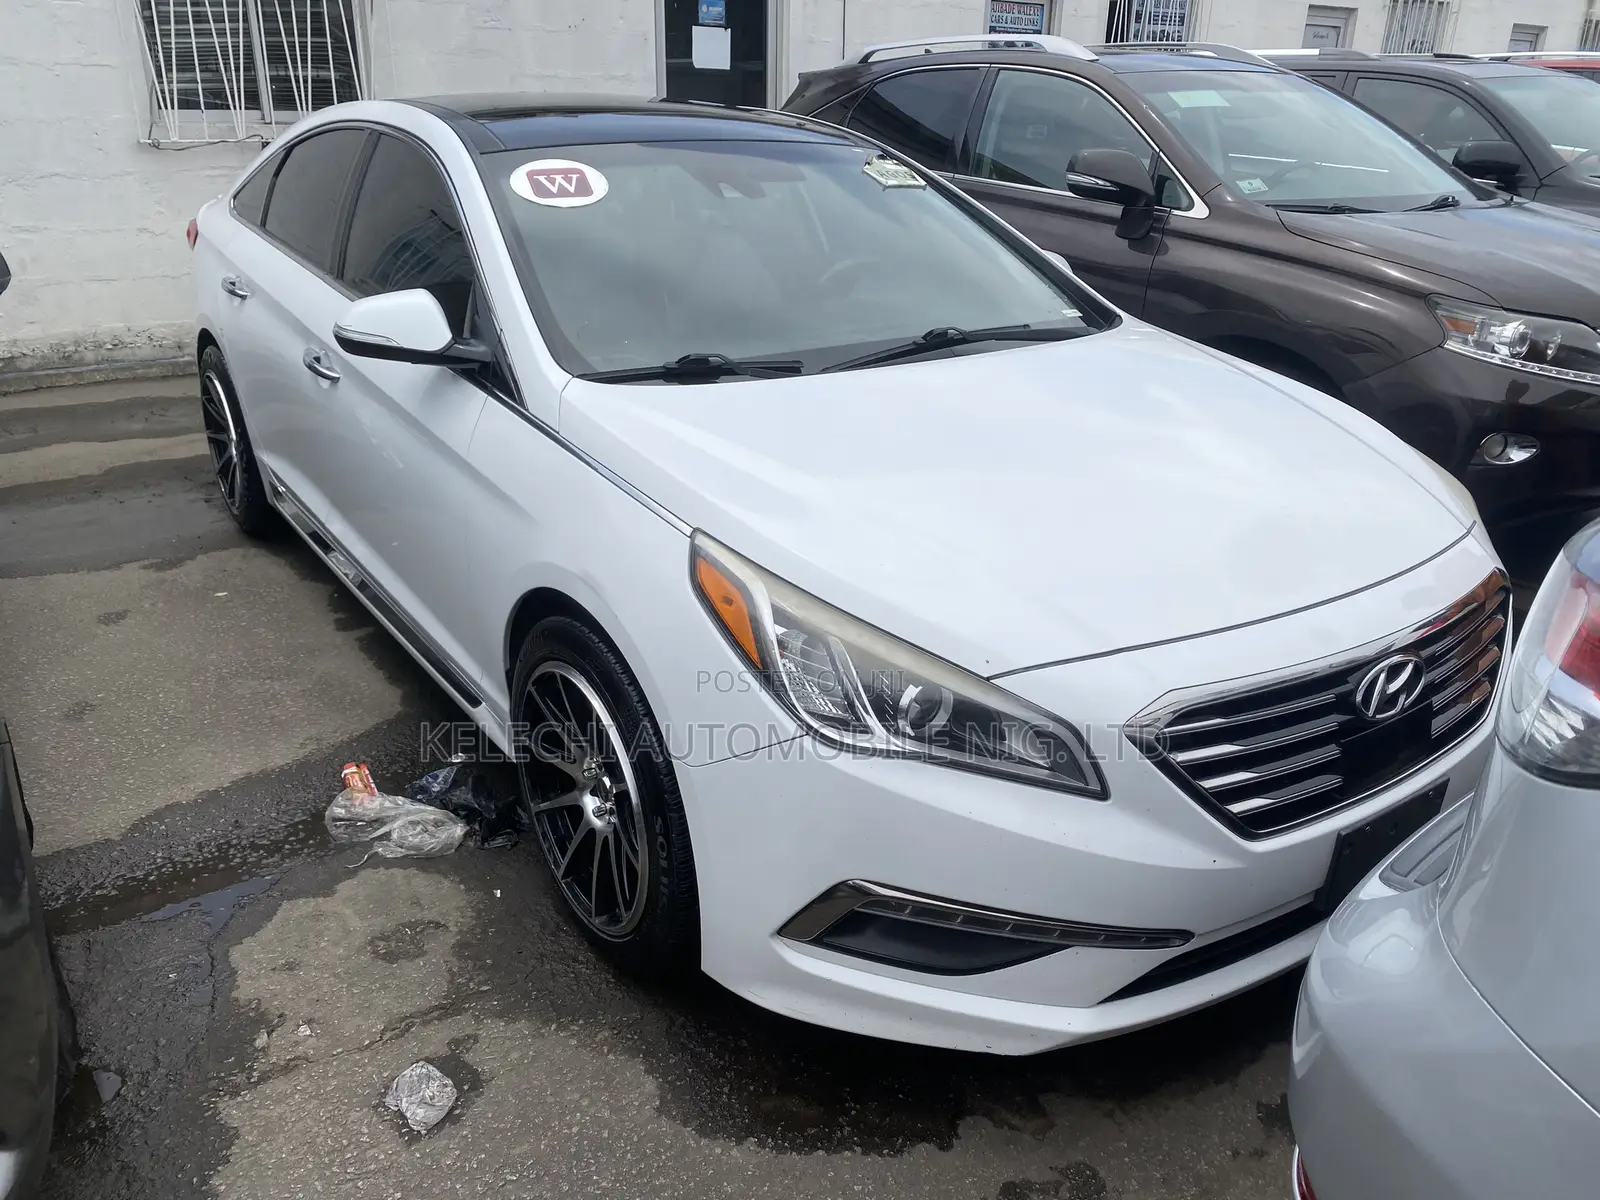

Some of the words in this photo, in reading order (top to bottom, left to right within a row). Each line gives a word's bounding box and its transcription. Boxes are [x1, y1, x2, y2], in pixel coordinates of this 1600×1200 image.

[990, 15, 1004, 24] CARS
[1010, 16, 1024, 25] AUTO
[1024, 18, 1039, 27] LINKS
[533, 174, 580, 194] W
